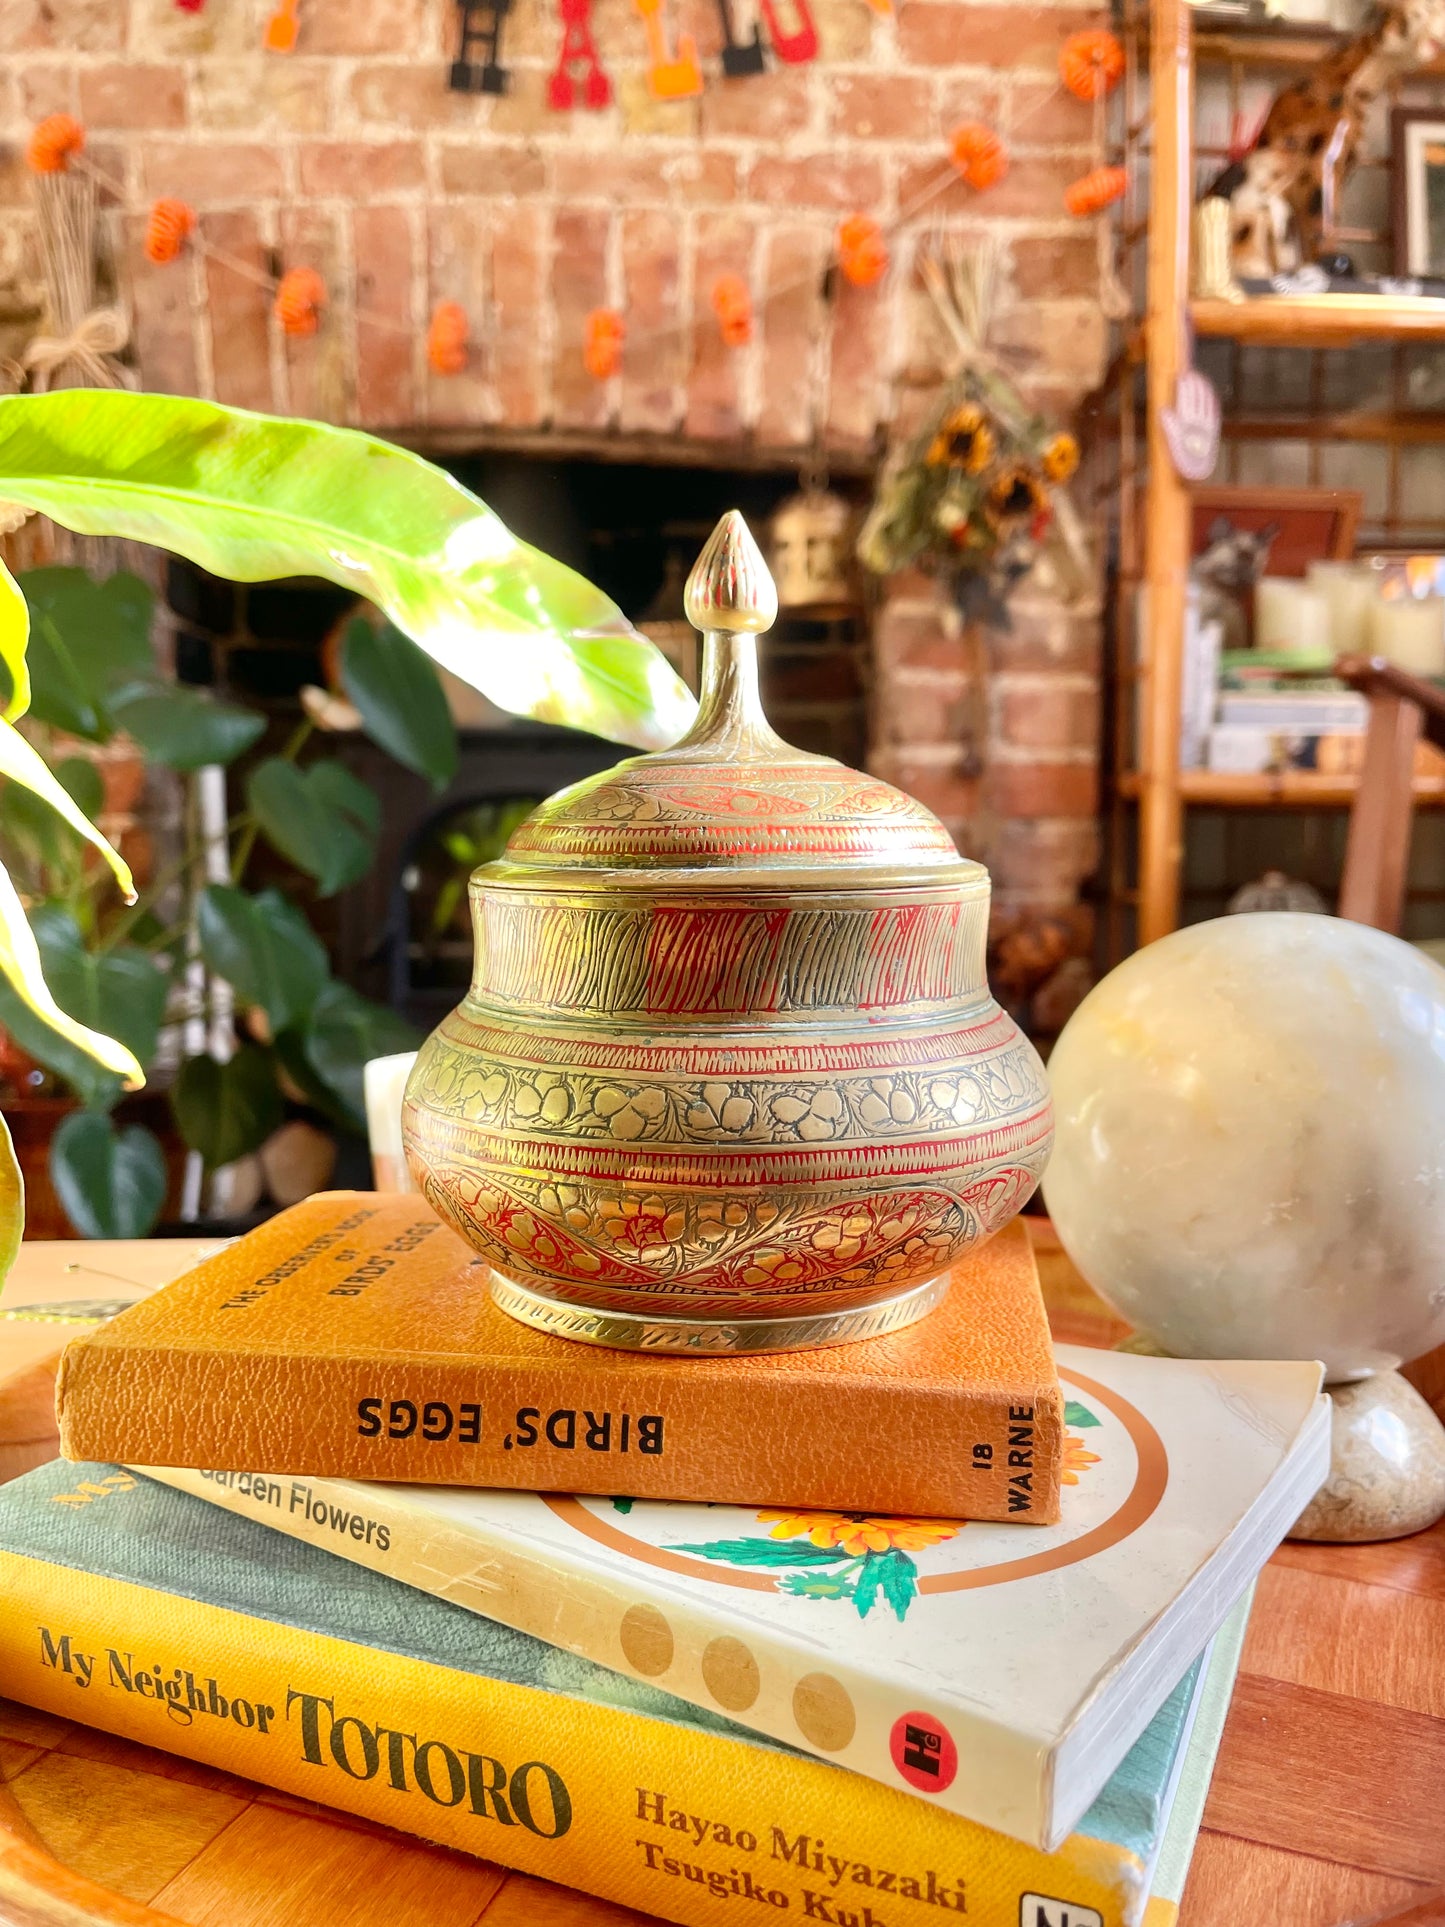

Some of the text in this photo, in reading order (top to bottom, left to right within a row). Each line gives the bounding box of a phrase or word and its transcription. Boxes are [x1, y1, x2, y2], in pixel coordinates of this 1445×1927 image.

[327, 1221, 440, 1296] BIRDS' EGGS
[335, 1249, 360, 1262] OF
[220, 1289, 268, 1309] THE
[357, 1397, 664, 1454] BIRDS' EGGS
[972, 1443, 993, 1469] 18
[1008, 1406, 1034, 1512] WARNE
[289, 1481, 391, 1551] Flowers
[38, 1627, 573, 1840] My Neighbor TOTORO
[635, 1787, 967, 1913] Hayao Miyazaki
[636, 1839, 789, 1908] Tsugiko
